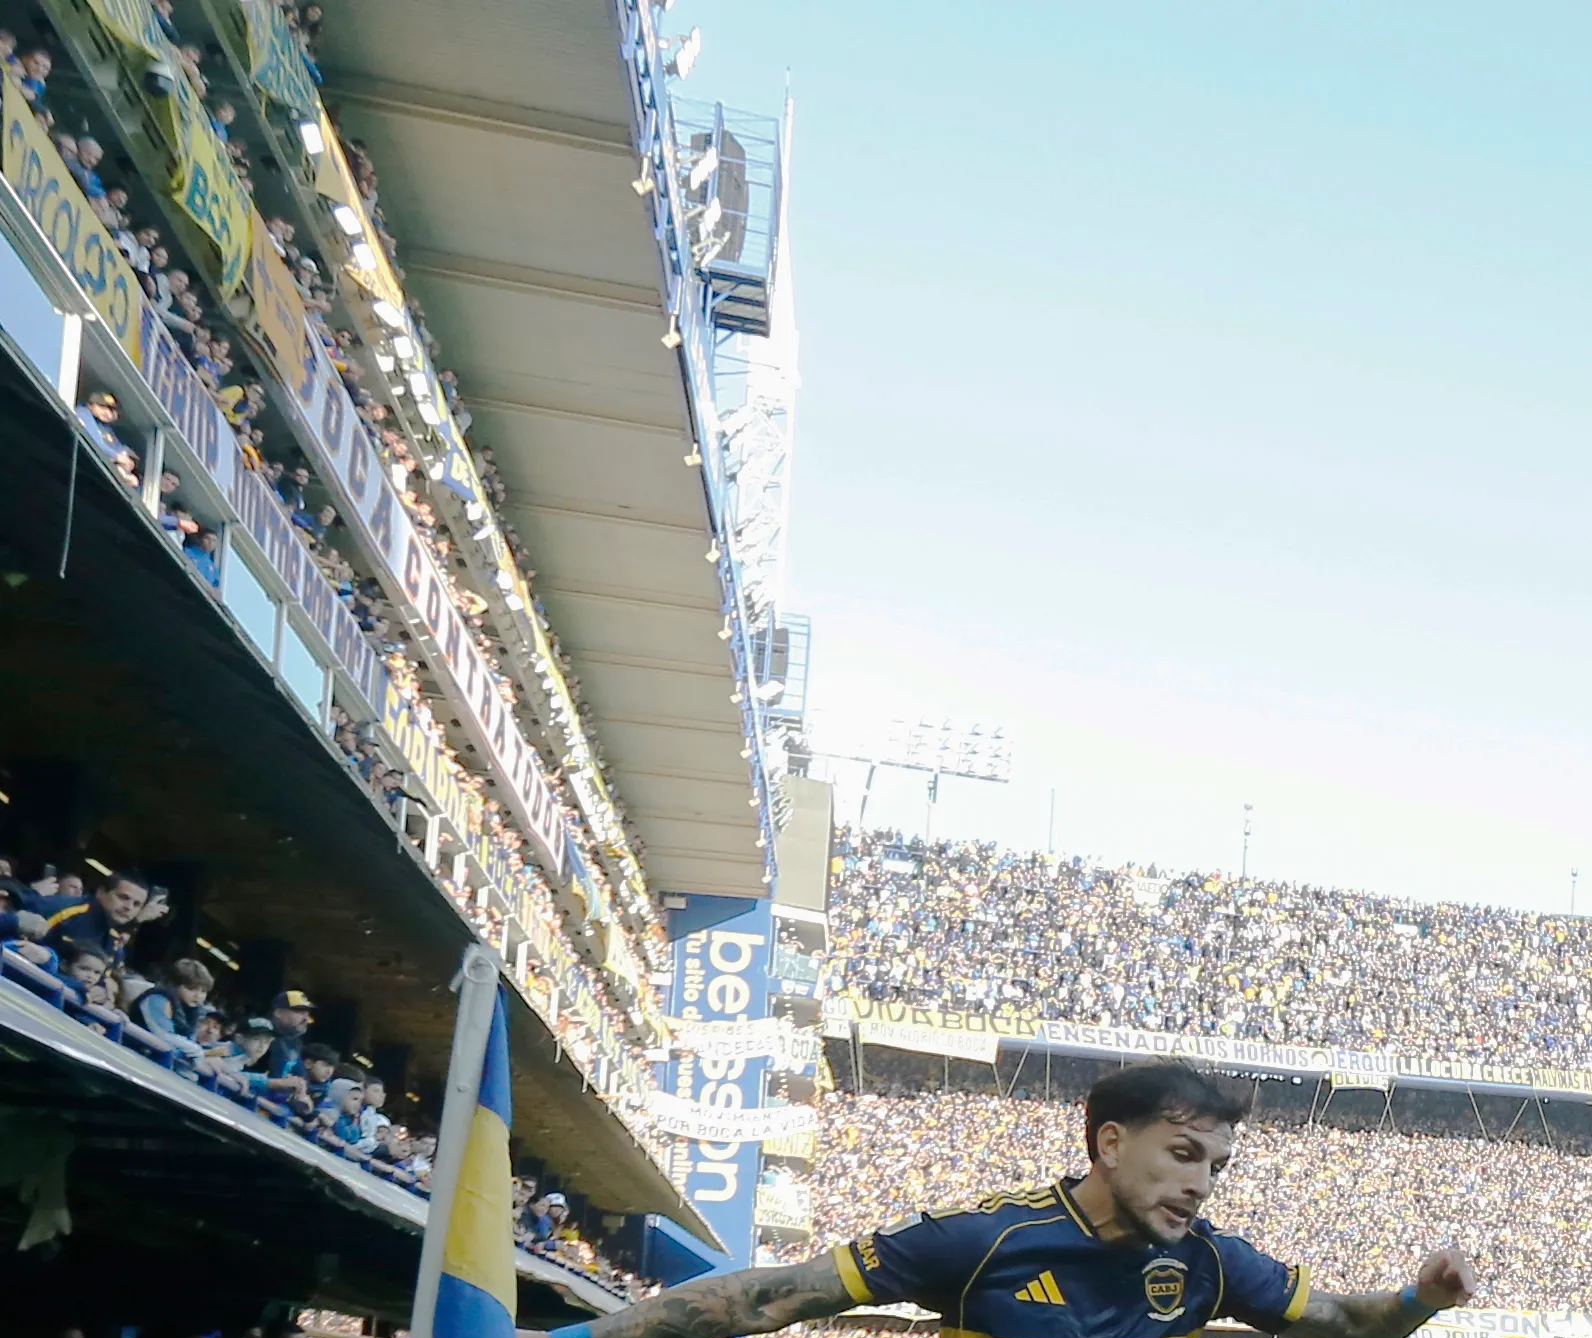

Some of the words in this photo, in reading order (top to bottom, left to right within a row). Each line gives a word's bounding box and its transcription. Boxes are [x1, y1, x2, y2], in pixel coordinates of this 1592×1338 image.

[1047, 1022, 1190, 1052] ENSENADA
[1196, 1038, 1229, 1060] LOS
[1234, 1043, 1309, 1068] HORNOS
[1400, 1056, 1420, 1076] LA
[1421, 1058, 1483, 1081] LOCURA
[1483, 1065, 1531, 1085] CRECE
[1151, 1284, 1178, 1294] CABJ
